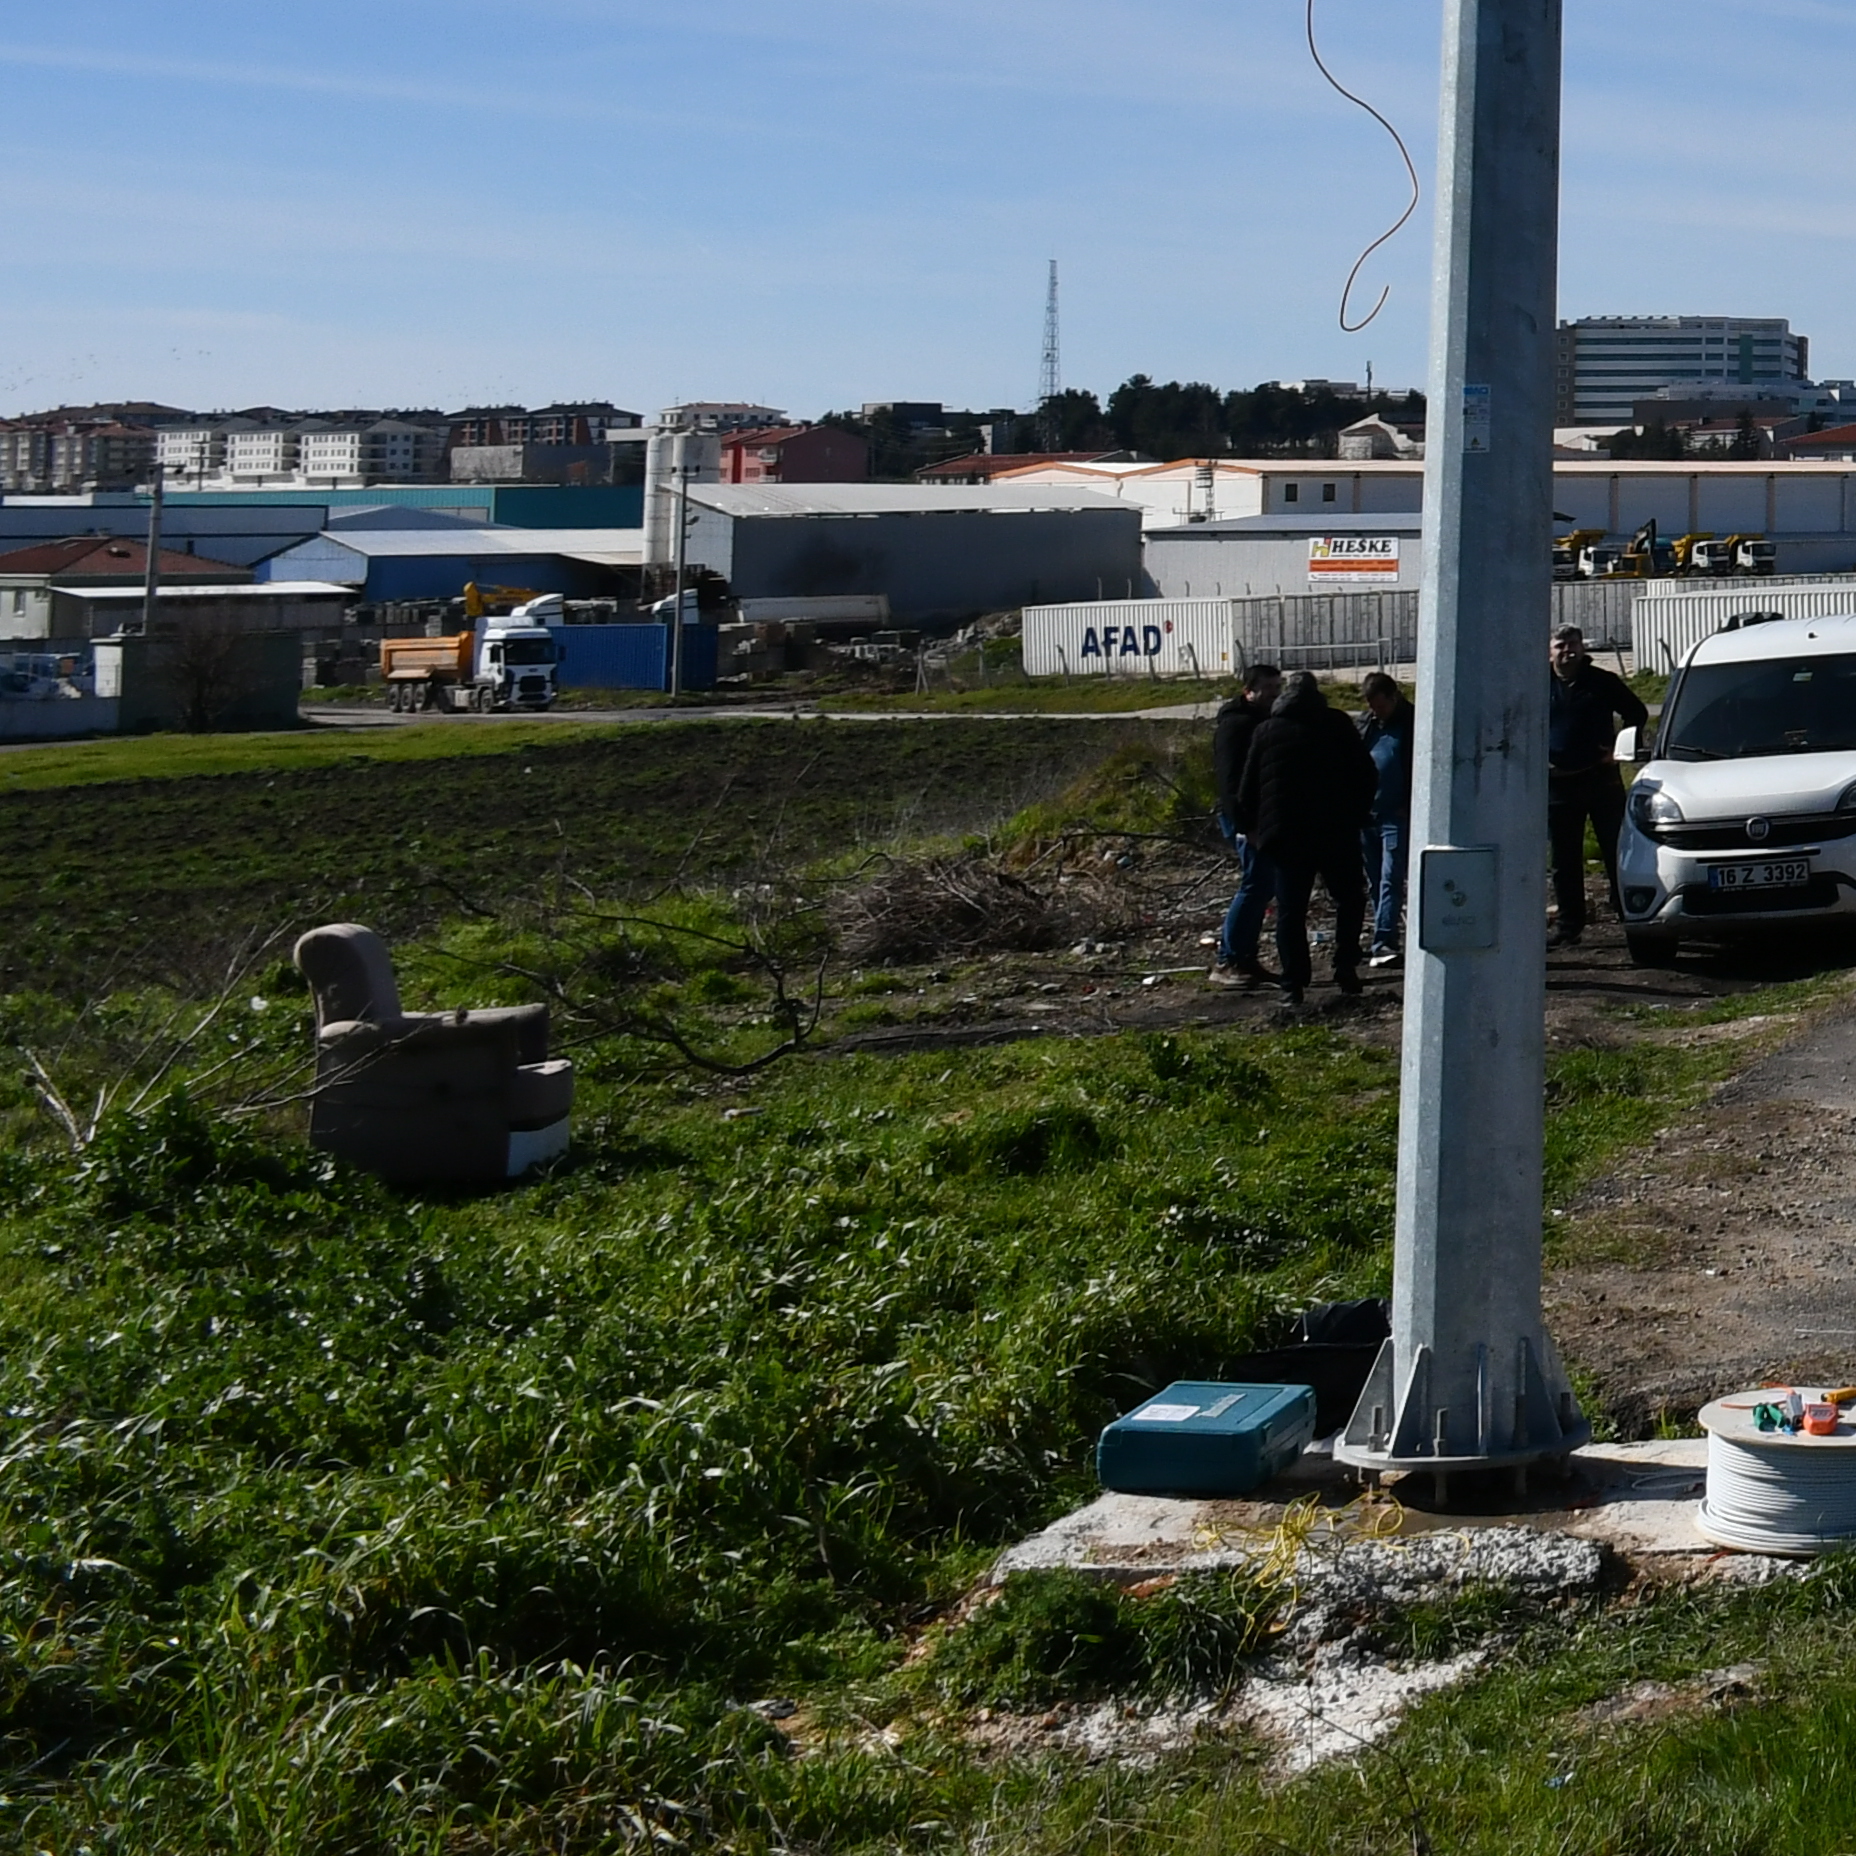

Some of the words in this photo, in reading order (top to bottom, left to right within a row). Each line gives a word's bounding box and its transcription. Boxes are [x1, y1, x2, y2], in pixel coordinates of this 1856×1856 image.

[1081, 625, 1162, 658] AFAD
[1719, 869, 1736, 885] 16
[1741, 867, 1755, 883] Z
[1763, 863, 1806, 882] 3392
